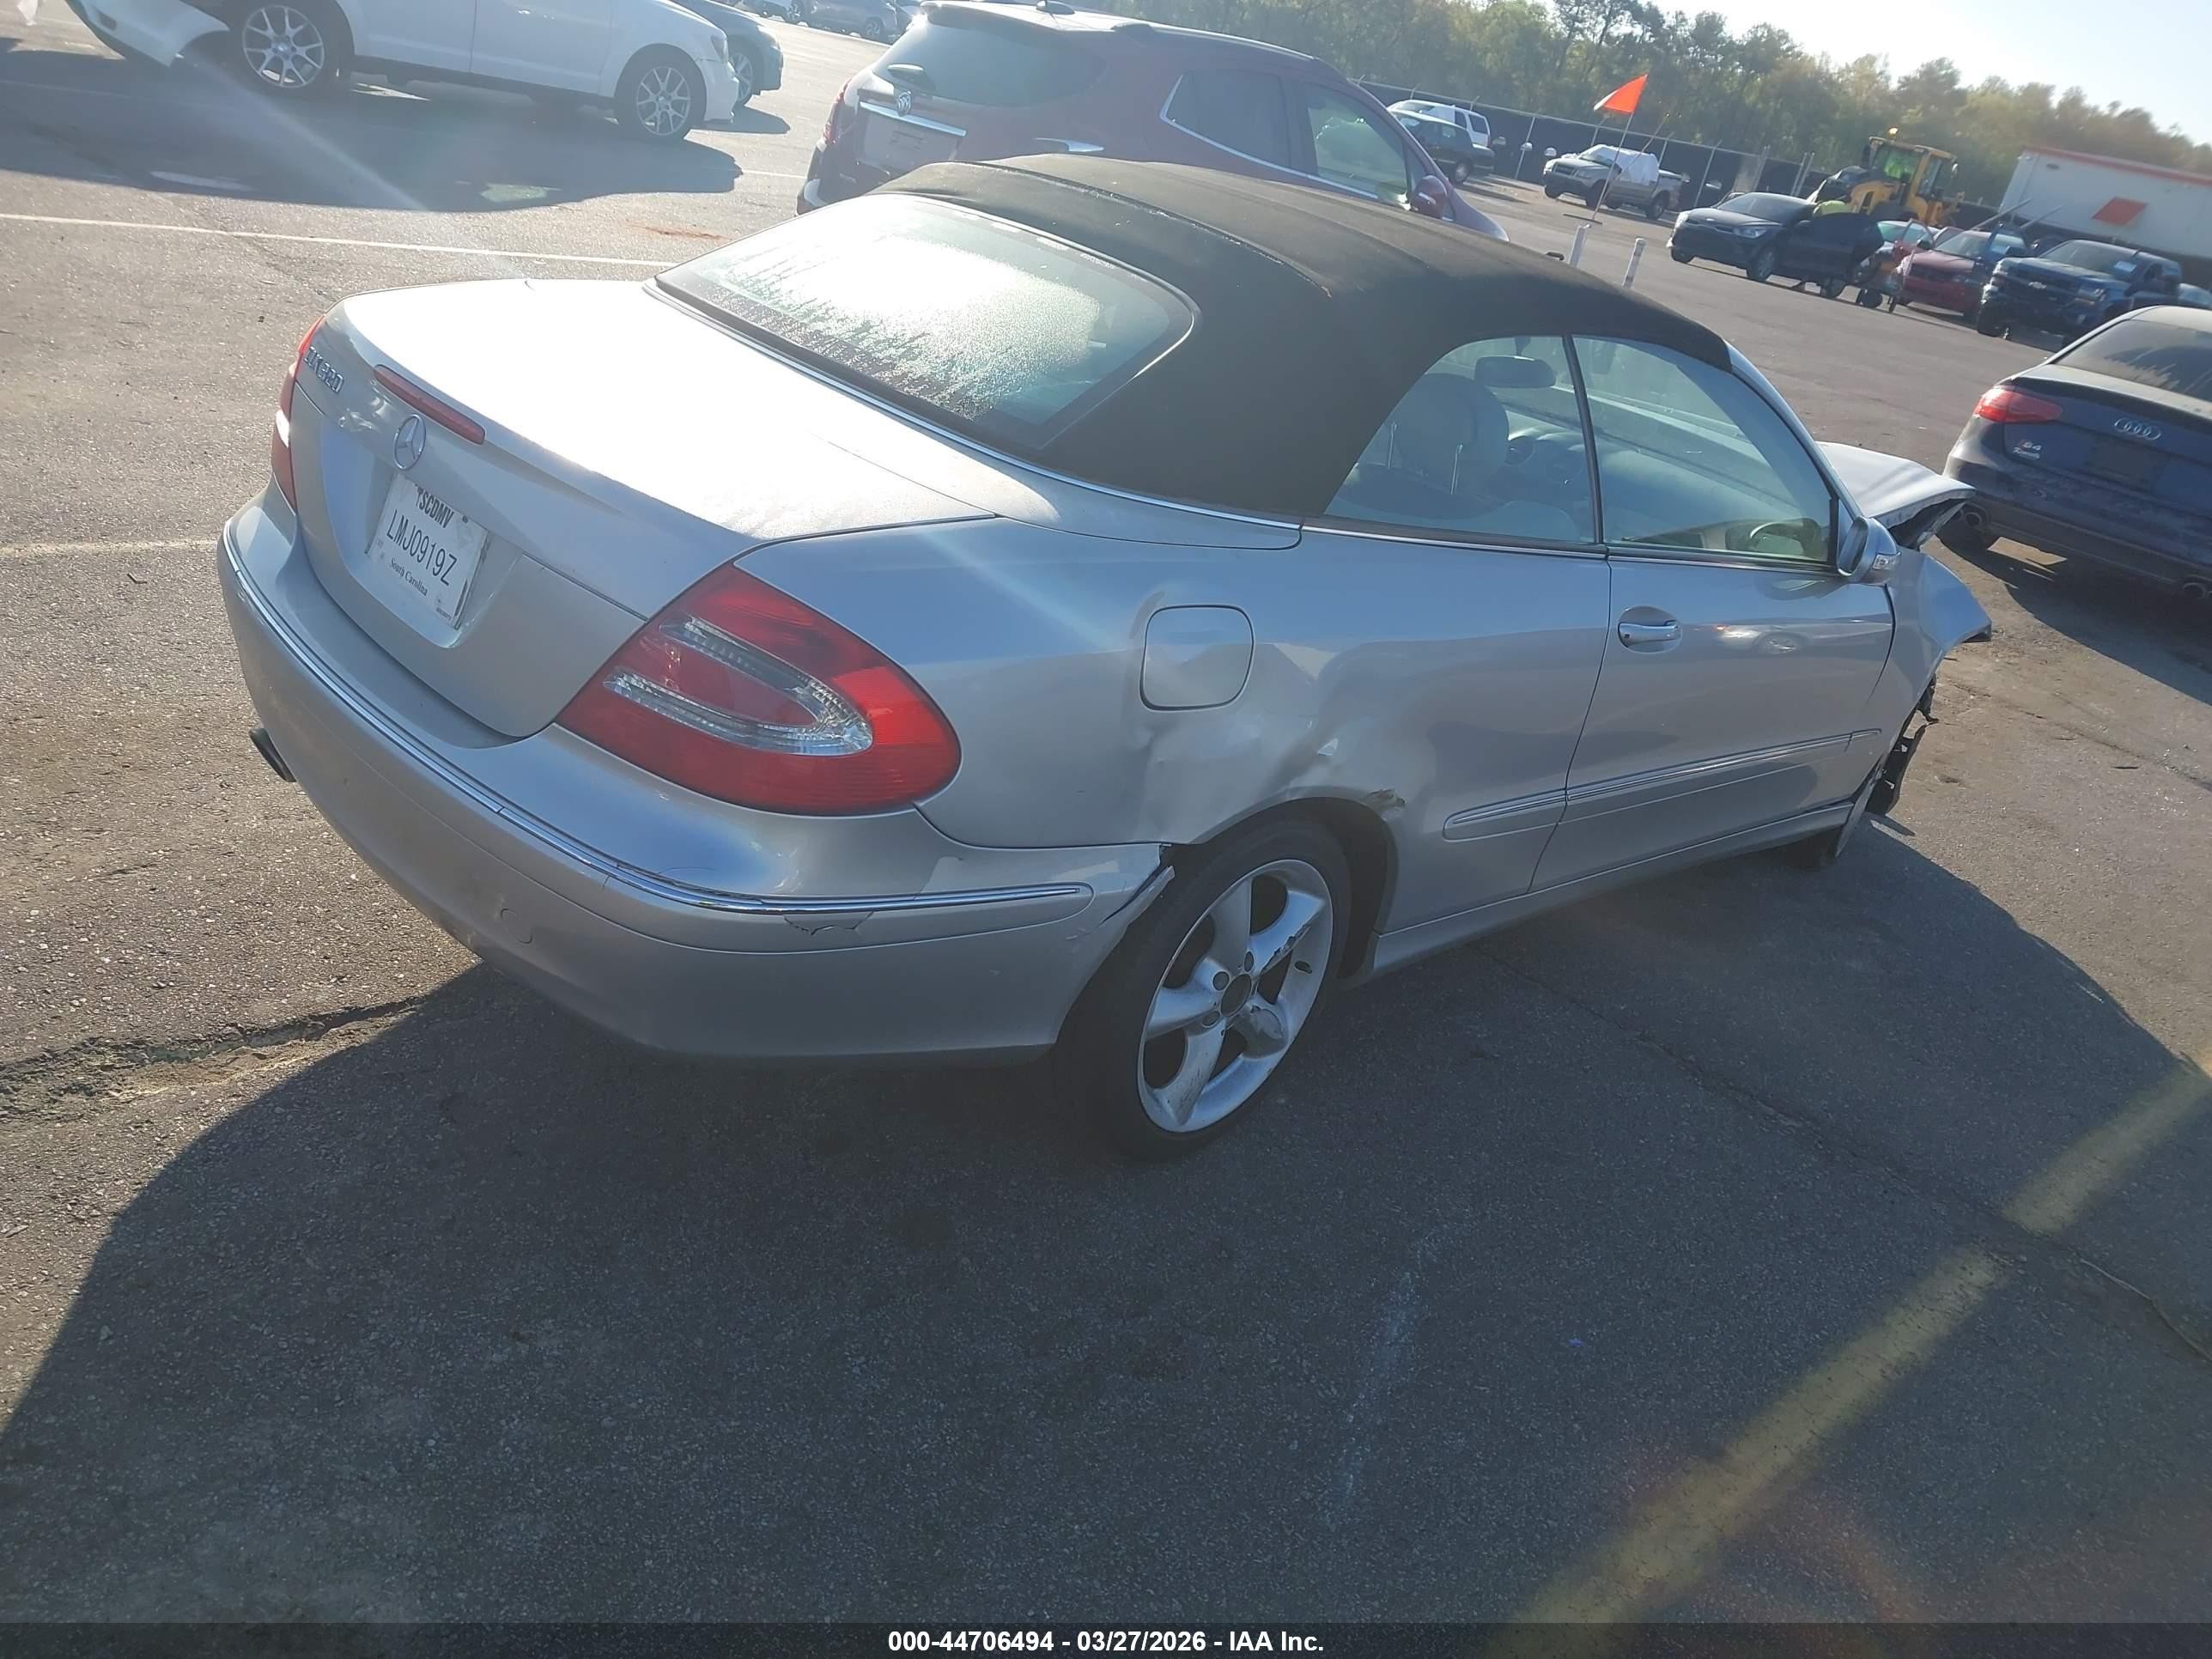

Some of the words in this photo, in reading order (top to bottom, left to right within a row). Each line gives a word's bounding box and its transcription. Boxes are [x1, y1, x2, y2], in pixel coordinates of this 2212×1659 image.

[386, 508, 458, 586] LMJ0919Z
[390, 557, 405, 578] South
[404, 570, 428, 597] Carolina
